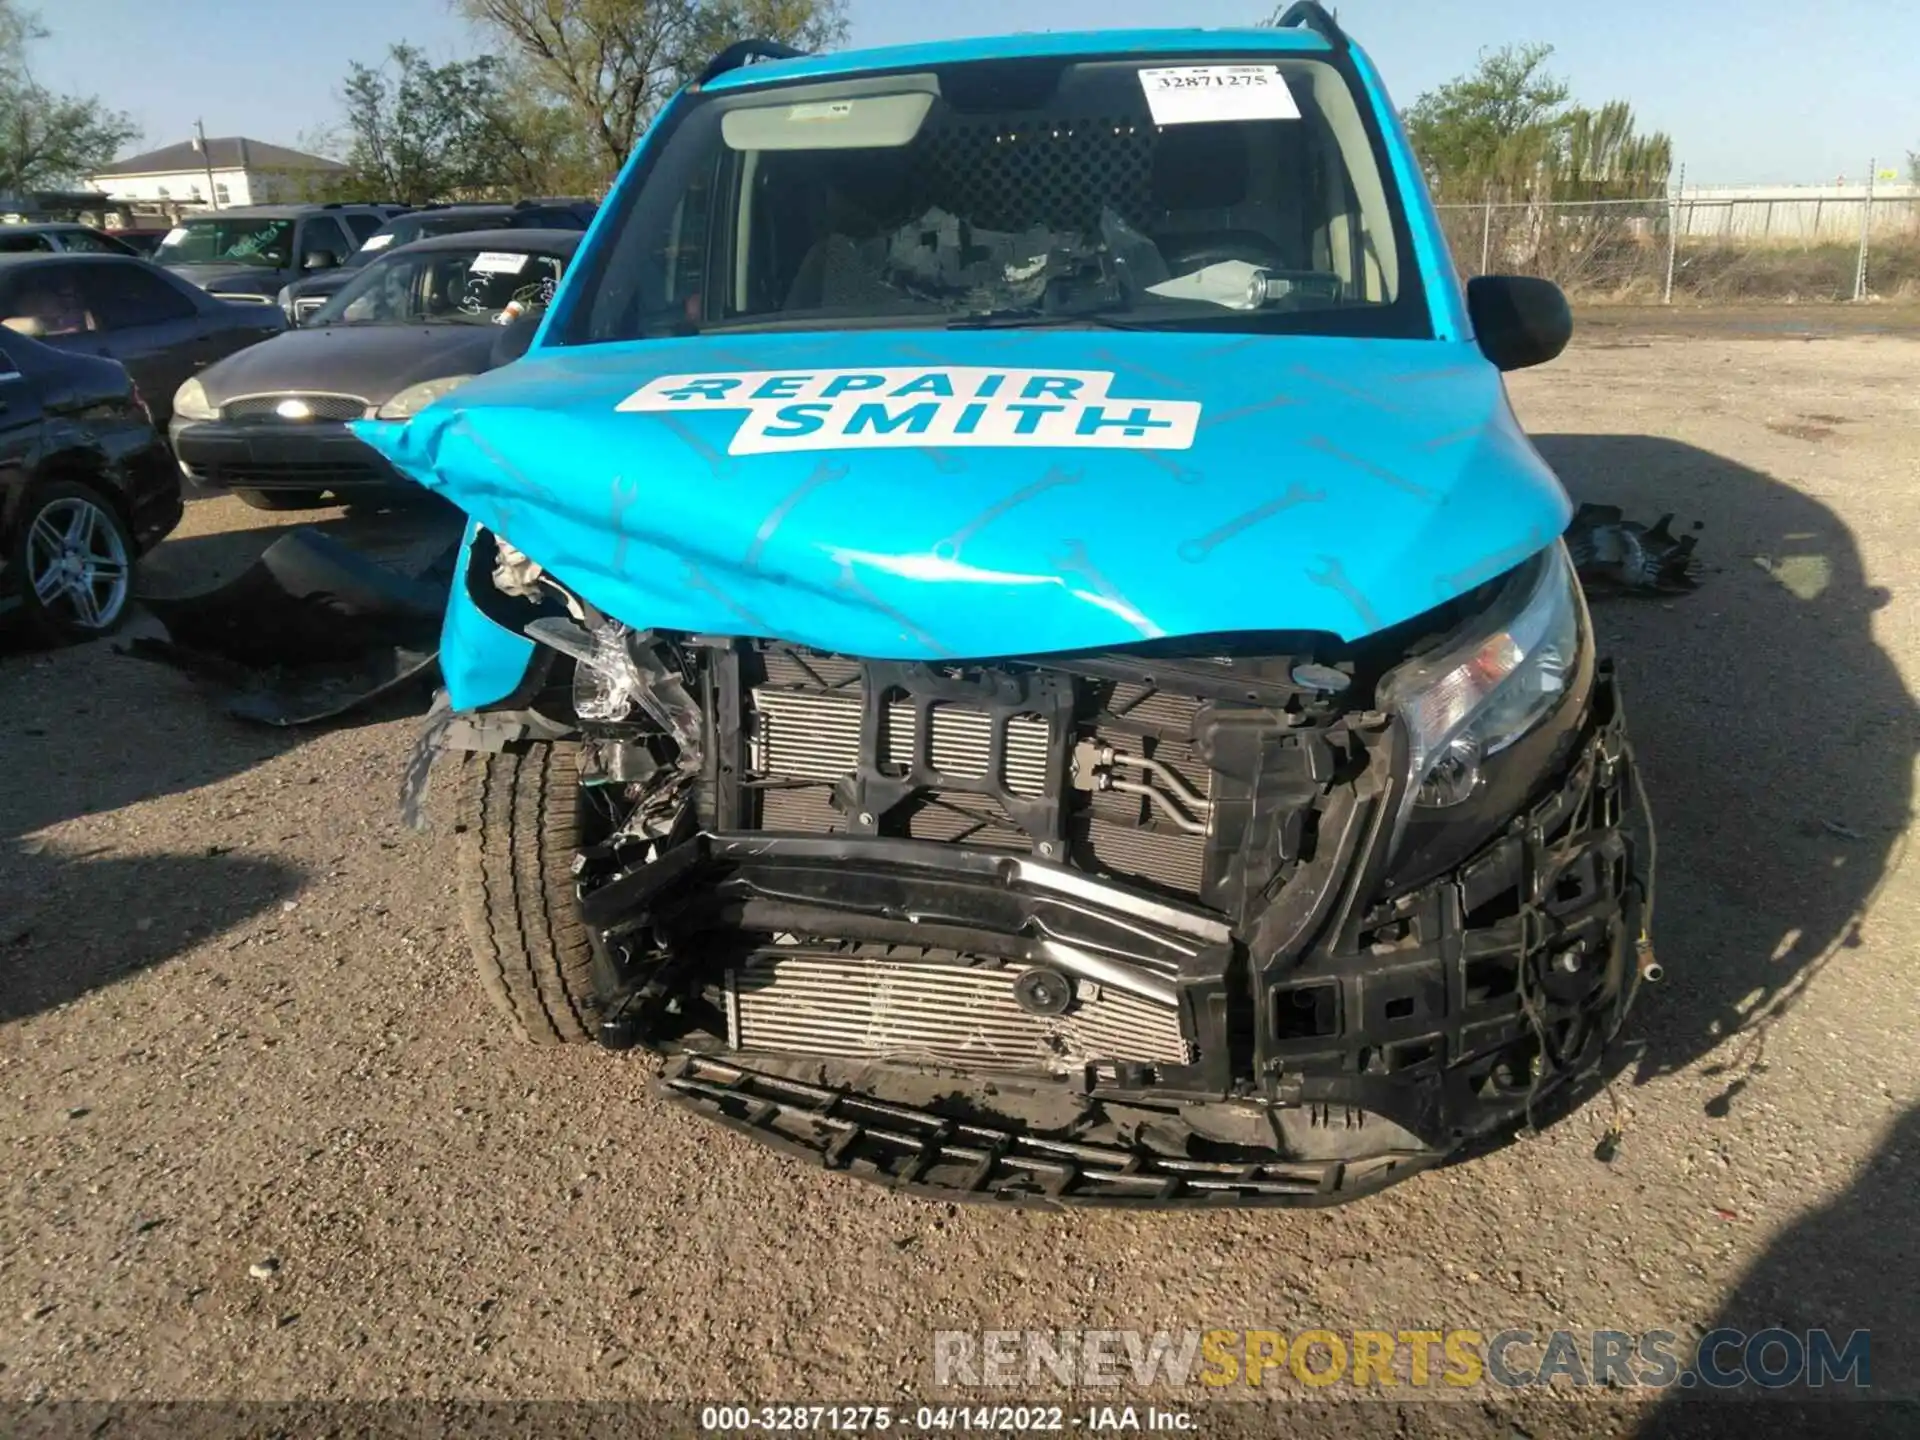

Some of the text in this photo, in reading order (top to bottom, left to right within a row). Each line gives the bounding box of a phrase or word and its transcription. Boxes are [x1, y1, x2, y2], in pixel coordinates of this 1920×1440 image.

[1157, 75, 1269, 89] 32871275
[658, 372, 1085, 401] REPAIR
[761, 403, 1173, 438] SMITH
